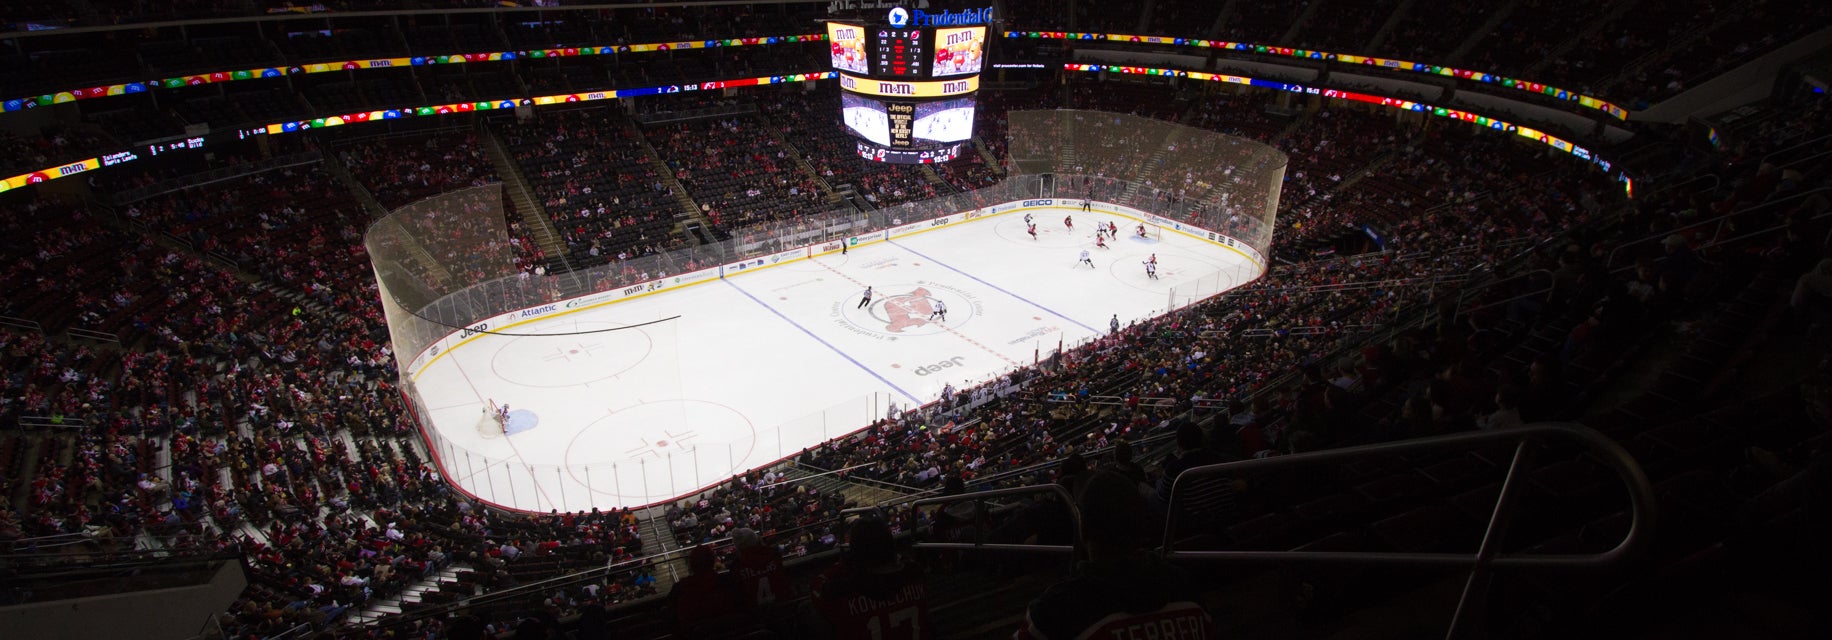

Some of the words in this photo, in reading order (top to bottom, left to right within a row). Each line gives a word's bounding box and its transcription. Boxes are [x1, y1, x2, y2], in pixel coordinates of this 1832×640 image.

[912, 8, 983, 27] Prudential
[888, 104, 913, 113] Jeep
[1023, 199, 1052, 207] GEICO
[932, 217, 949, 226] Jeep
[823, 243, 840, 252] Wawa
[522, 304, 556, 317] Atlantic
[460, 322, 488, 339] Jeep
[914, 356, 964, 376] Jeep
